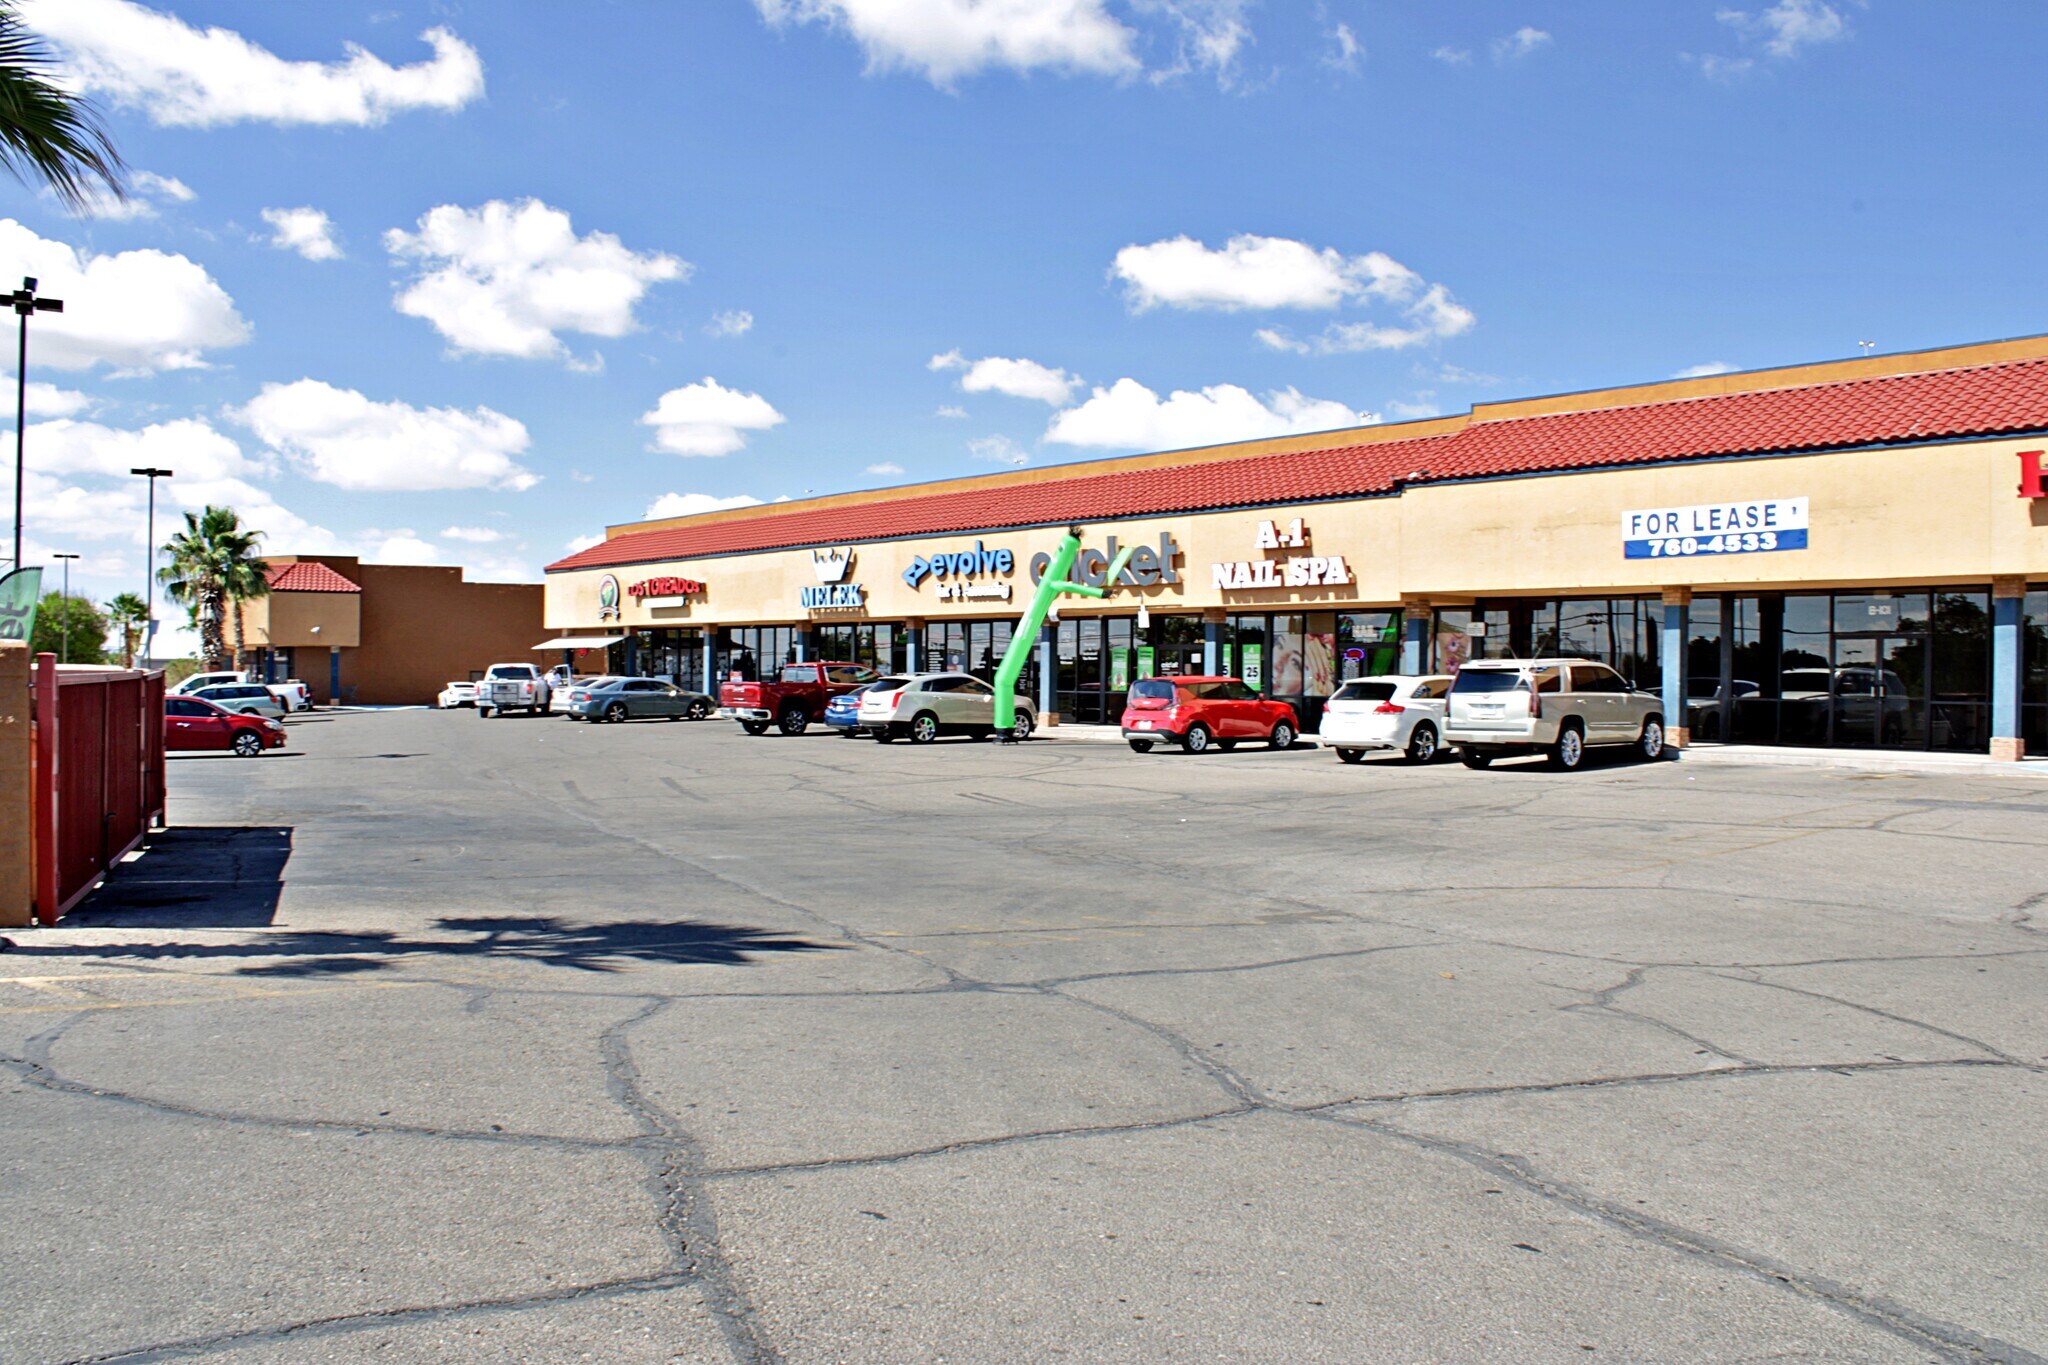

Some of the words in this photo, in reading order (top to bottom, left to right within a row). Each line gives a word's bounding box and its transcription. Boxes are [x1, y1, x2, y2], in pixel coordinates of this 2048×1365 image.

[1255, 517, 1305, 549] A-1
[1632, 512, 1679, 535] FOR
[1693, 504, 1777, 532] LEASE
[931, 540, 1012, 577] evolve
[1030, 532, 1177, 587] cicket
[1648, 532, 1778, 557] 760-4533
[1212, 560, 1282, 590] NAIL
[1284, 556, 1350, 587] SPA
[800, 583, 864, 609] MELEK
[1246, 666, 1259, 678] 25
